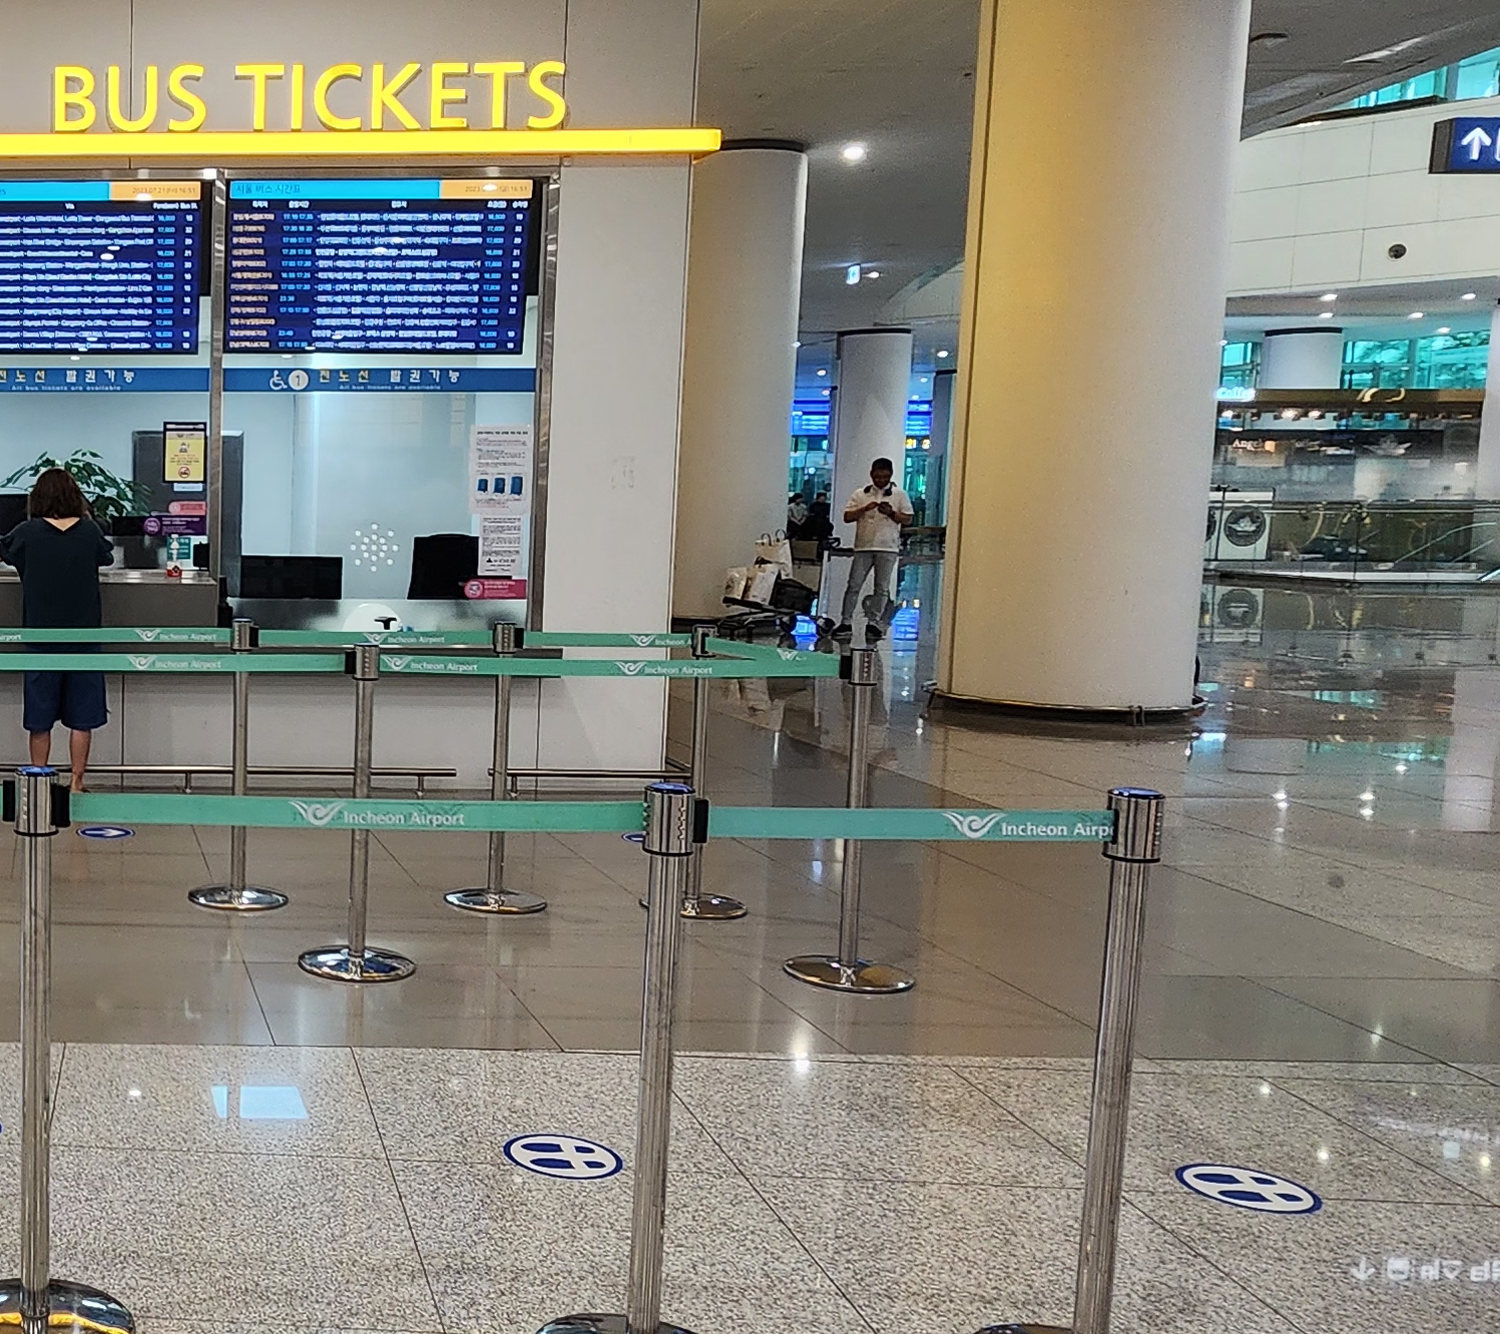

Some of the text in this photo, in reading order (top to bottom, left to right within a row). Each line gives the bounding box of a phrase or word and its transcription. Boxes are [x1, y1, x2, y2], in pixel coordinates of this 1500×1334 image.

[53, 62, 567, 132] BUS TICKETS
[236, 184, 300, 195] 서울 버스 시간표
[296, 374, 301, 385] 1
[419, 636, 444, 644] Airport
[655, 638, 685, 646] Incheon
[410, 662, 478, 672] Incheon Airport
[644, 666, 713, 675] Incheon Airport
[344, 811, 465, 827] Incheon Airport
[1002, 822, 1114, 839] Incheon Airp
